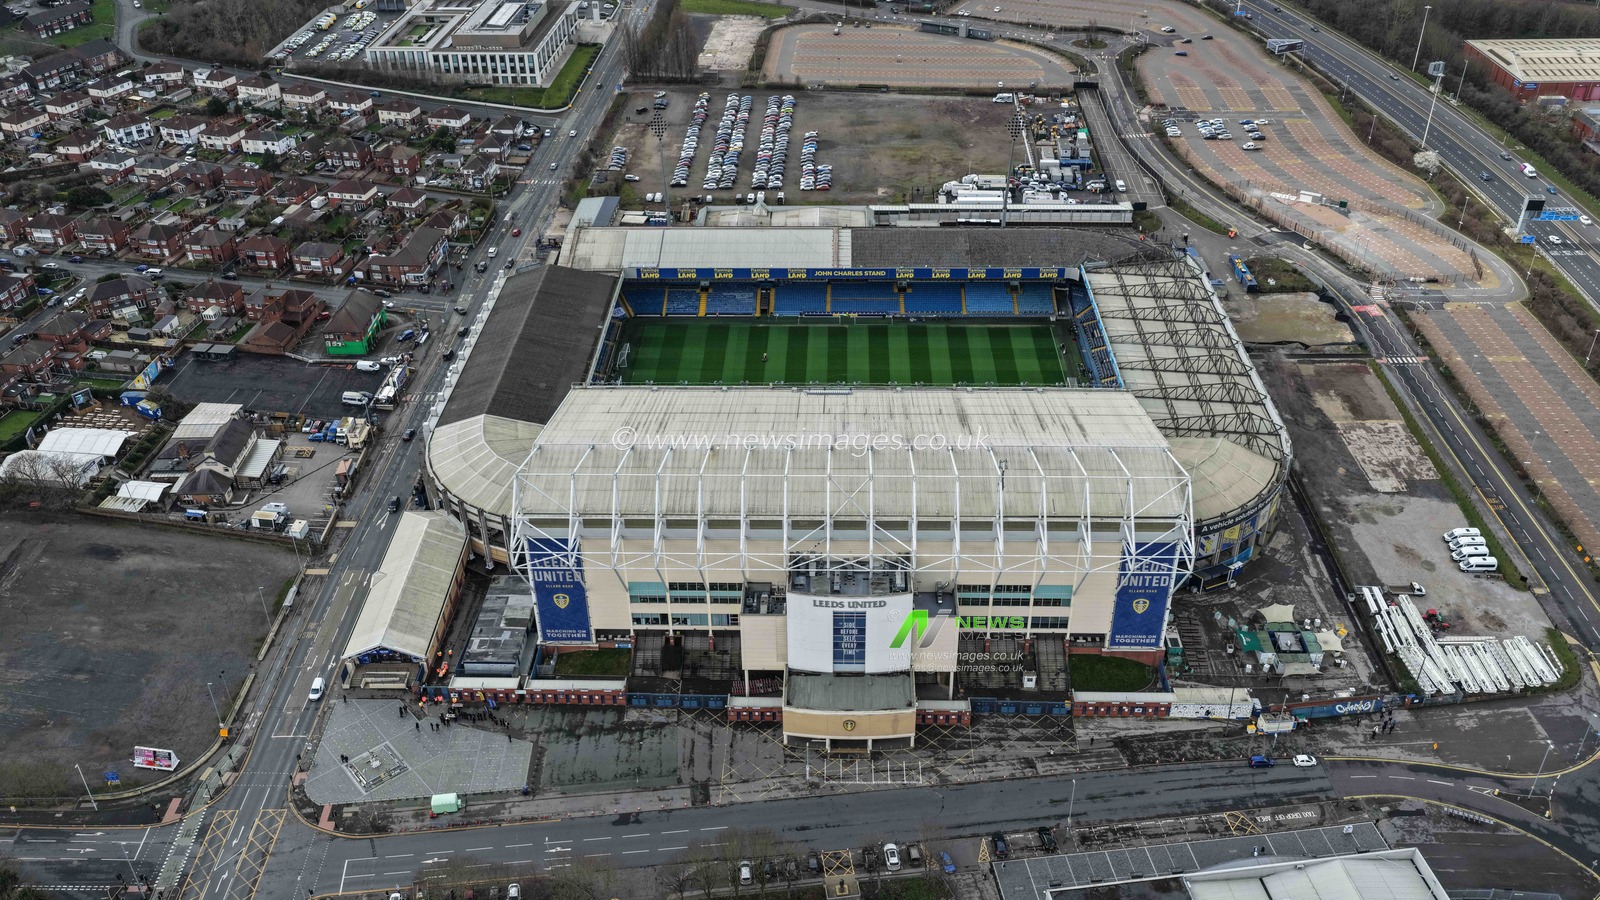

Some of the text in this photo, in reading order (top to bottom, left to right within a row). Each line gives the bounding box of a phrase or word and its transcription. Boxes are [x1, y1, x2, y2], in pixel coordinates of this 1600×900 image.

[1210, 518, 1234, 530] vehicle
[1235, 507, 1257, 522] solution
[534, 571, 582, 582] UNITED
[1120, 576, 1169, 587] UNITED
[813, 600, 887, 608] LEEDS UNITED
[1286, 812, 1302, 820] DROP
